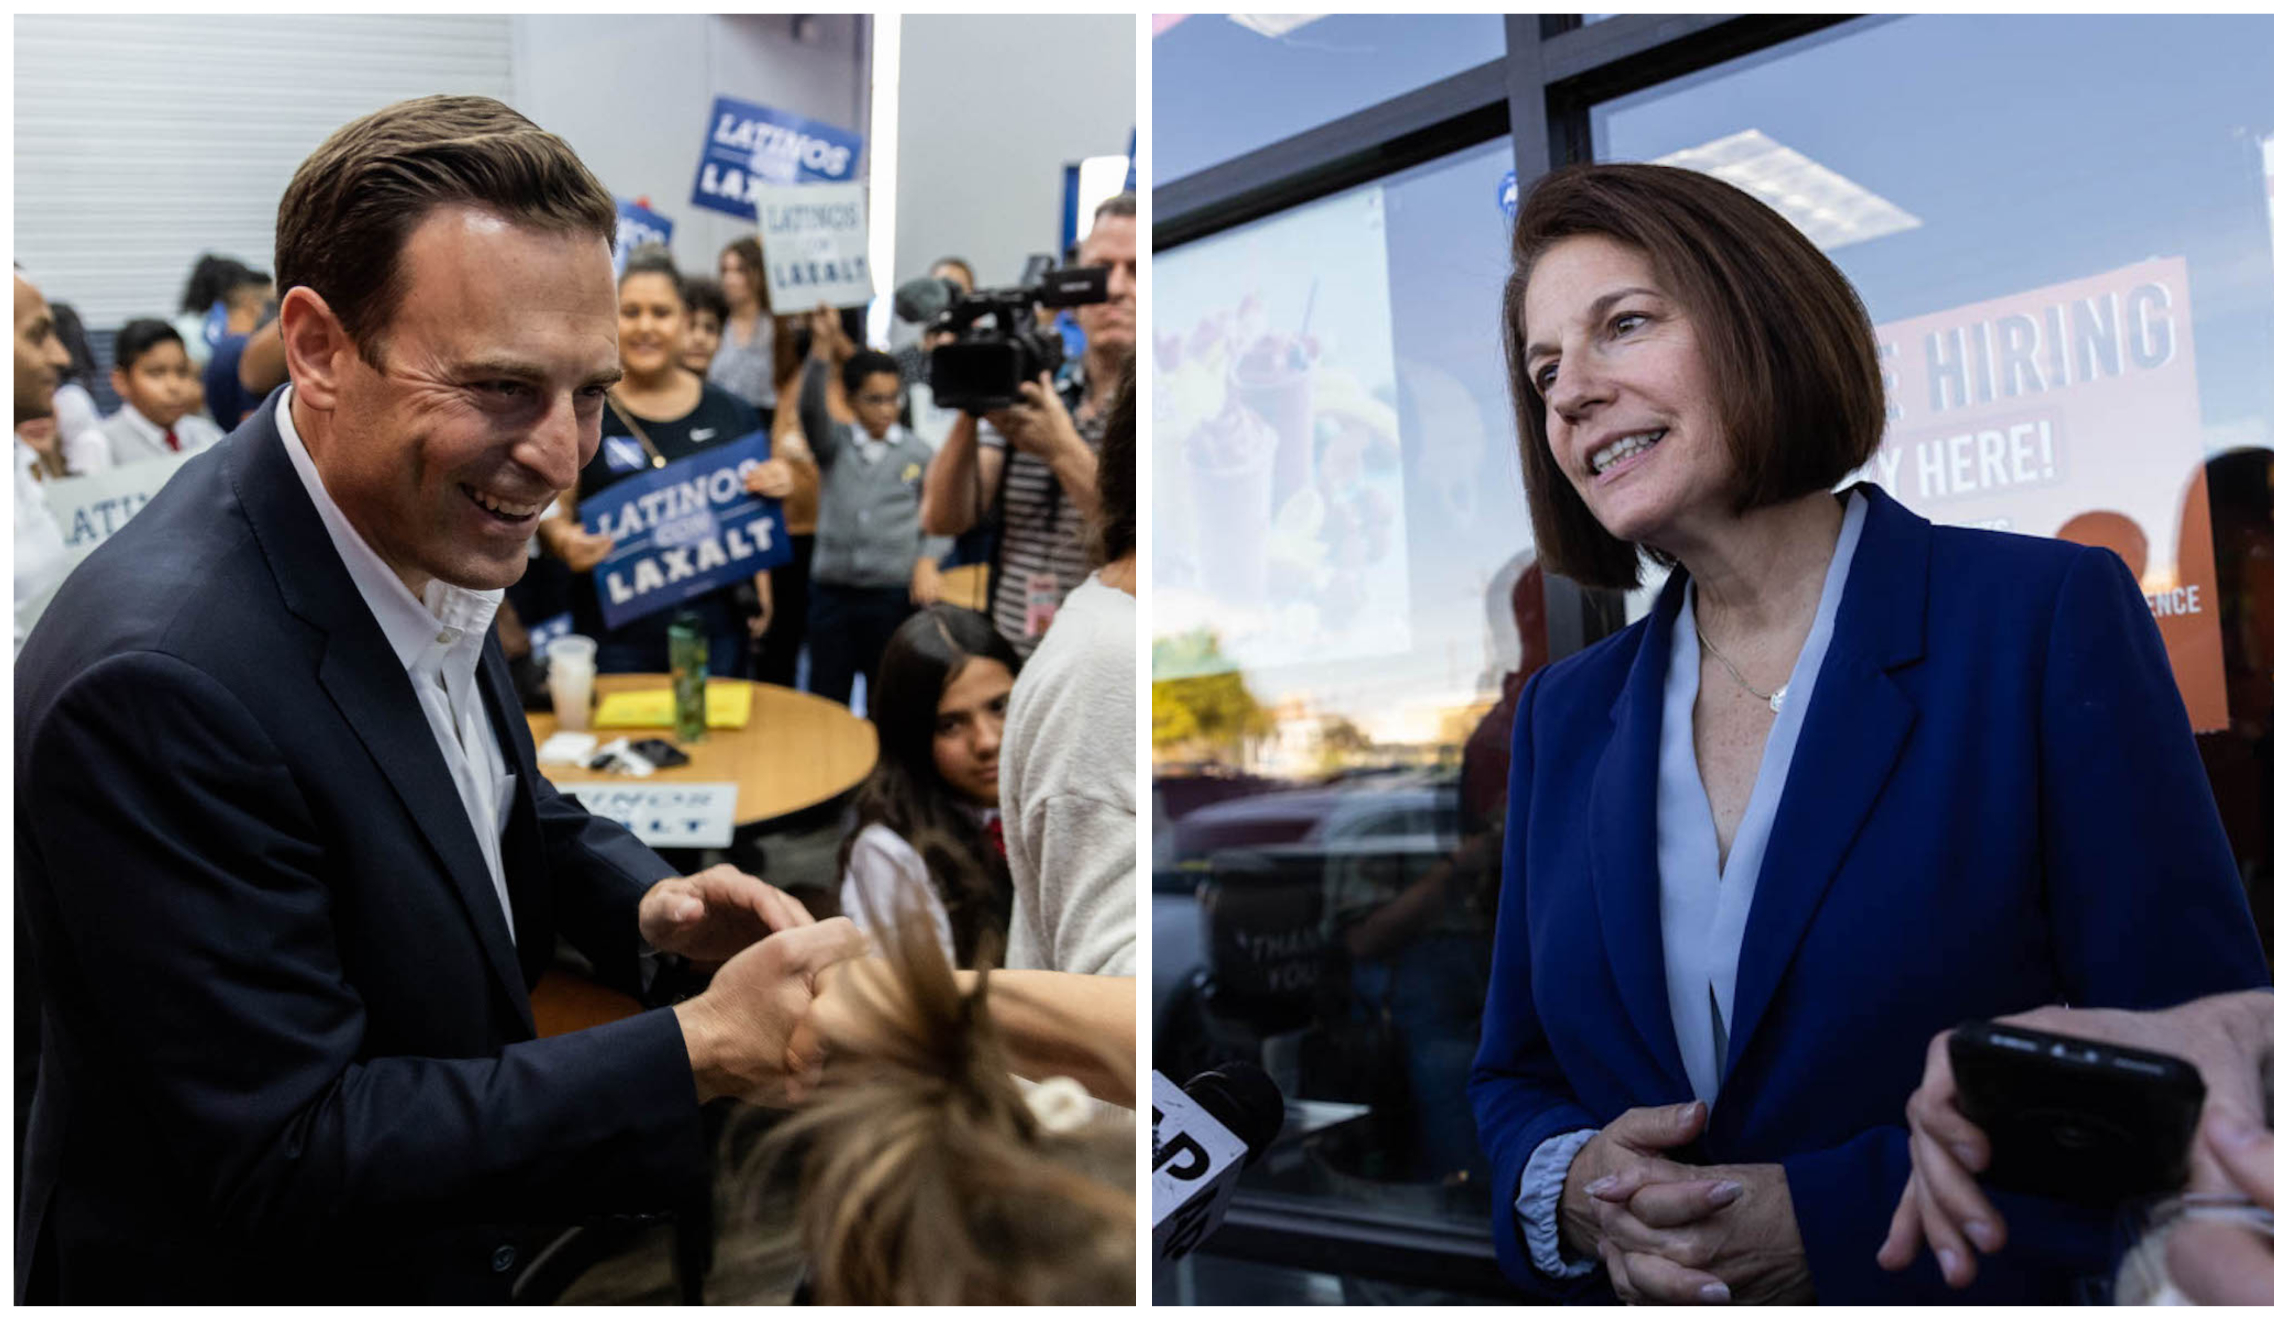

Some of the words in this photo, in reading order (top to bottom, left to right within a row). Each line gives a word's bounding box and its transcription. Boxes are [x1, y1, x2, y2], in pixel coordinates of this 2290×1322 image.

[713, 112, 851, 177] LATINOS
[768, 202, 858, 232] LATINOS
[774, 255, 868, 289] LAXALT
[1925, 281, 2177, 413] HIRING
[1916, 420, 2055, 498] HERE!
[597, 458, 760, 541] LATINOS
[606, 516, 775, 606] LAXALT
